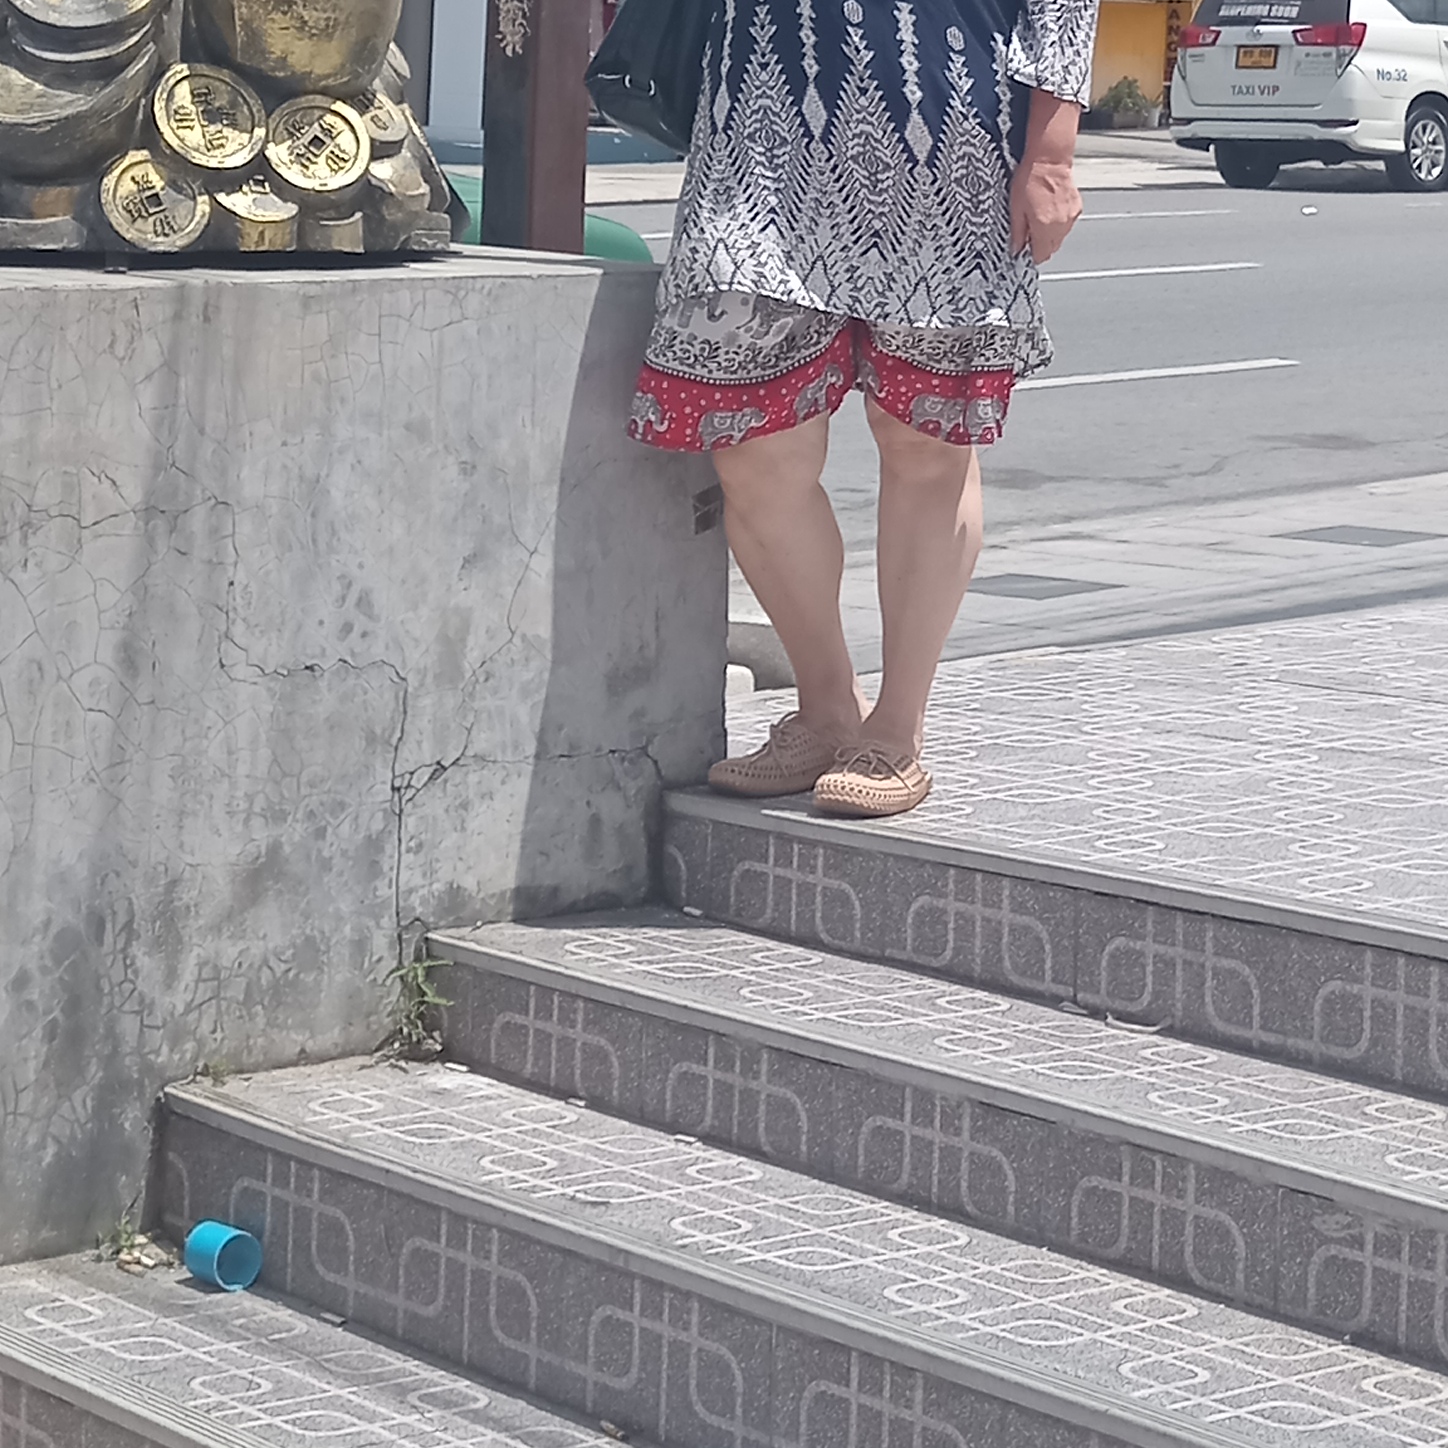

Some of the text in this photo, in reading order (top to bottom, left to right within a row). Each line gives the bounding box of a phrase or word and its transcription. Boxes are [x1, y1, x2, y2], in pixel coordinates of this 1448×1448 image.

[1376, 68, 1408, 82] No.32
[1231, 84, 1281, 97] TAXI VIP
